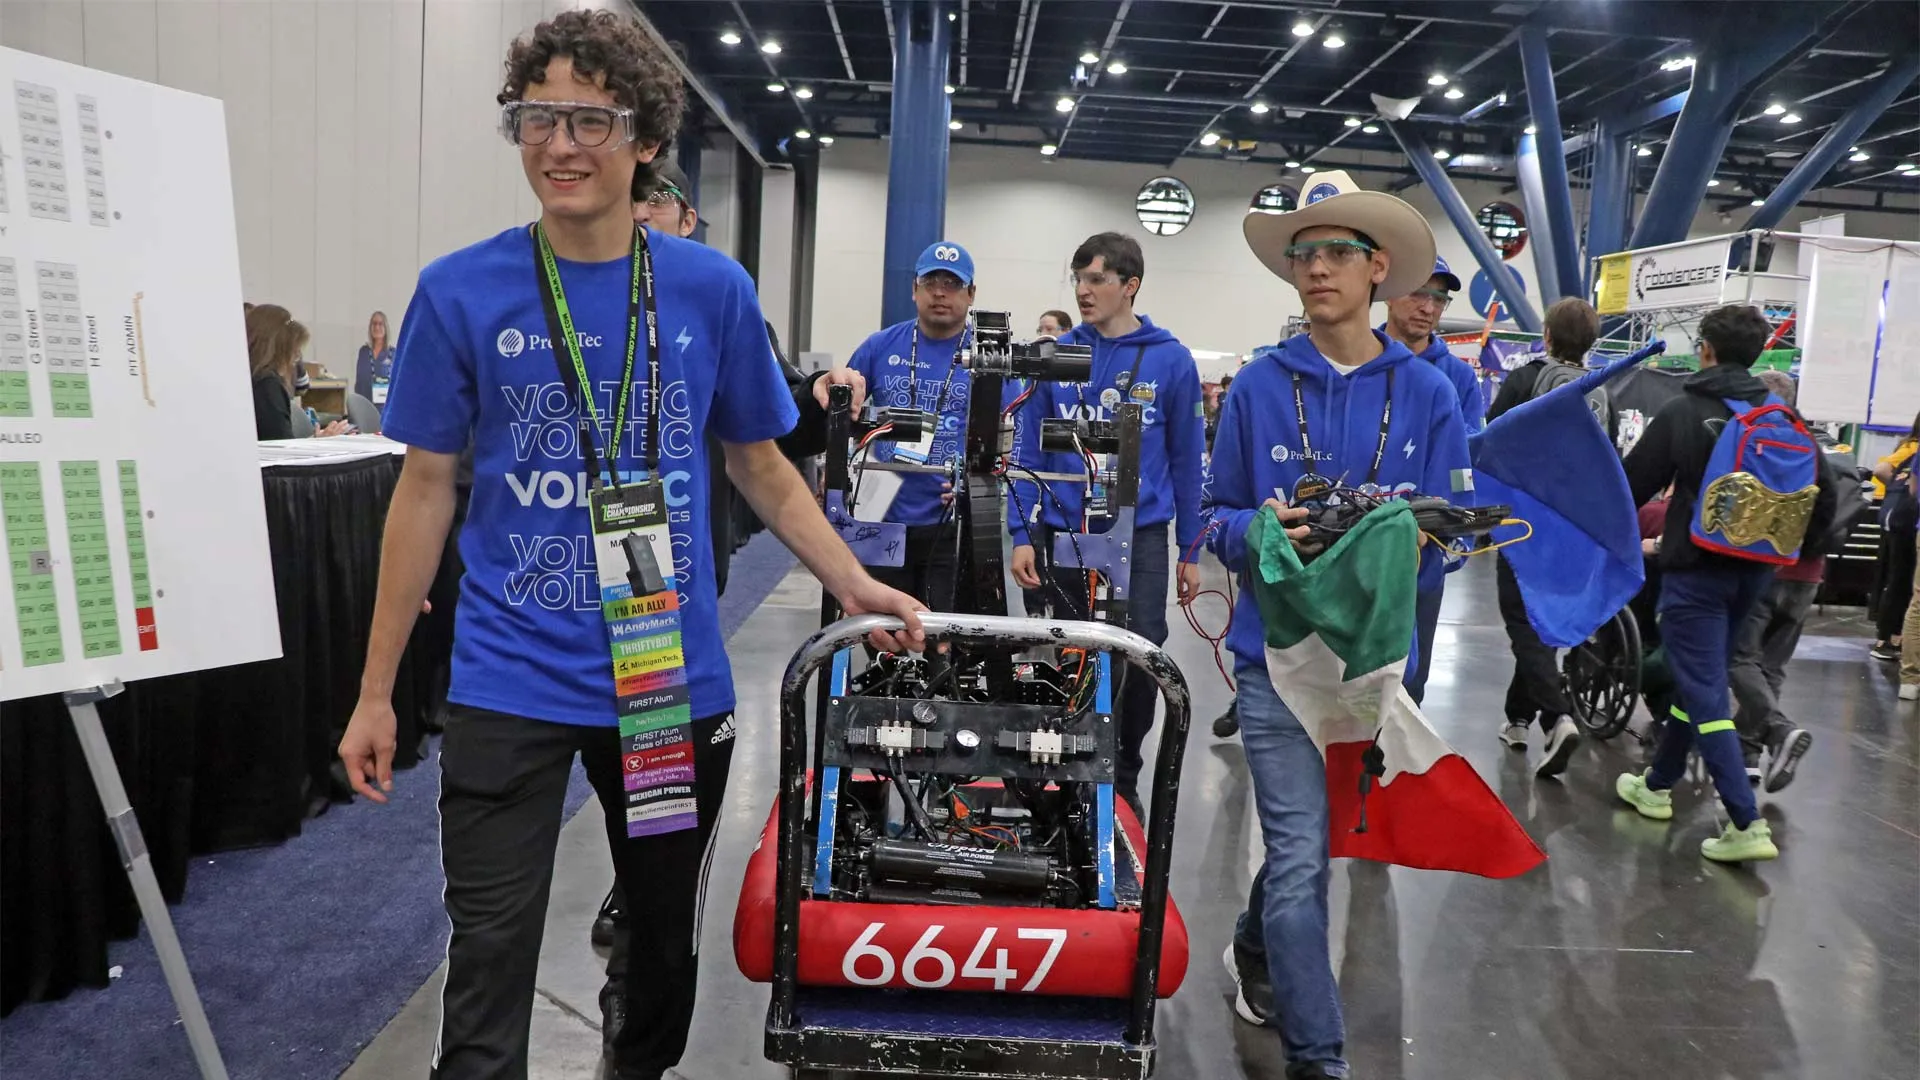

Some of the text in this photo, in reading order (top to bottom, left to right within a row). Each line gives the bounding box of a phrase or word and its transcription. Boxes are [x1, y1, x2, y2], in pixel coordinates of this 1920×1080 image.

[26, 309, 41, 349] Street
[85, 315, 101, 367] H Street
[124, 315, 139, 377] PIT ADMIN
[529, 332, 602, 350] PreTec
[1058, 403, 1157, 425] VOLC
[510, 420, 693, 462] VOLTEC
[509, 533, 693, 572] VOLC
[614, 598, 667, 619] I'M AN ALLY
[624, 616, 675, 634] AndyMark
[620, 635, 673, 656] THRIFTYBOT
[630, 654, 679, 669] Michigan Tech
[629, 694, 674, 710] FIRST Alum
[632, 734, 683, 752] Class of 2024
[634, 727, 679, 743] FIRST Alum
[711, 729, 736, 744] adida
[661, 751, 686, 762] enough
[629, 785, 692, 802] MEXICAN POWER
[971, 853, 995, 861] POWER
[842, 922, 1067, 992] 6647
